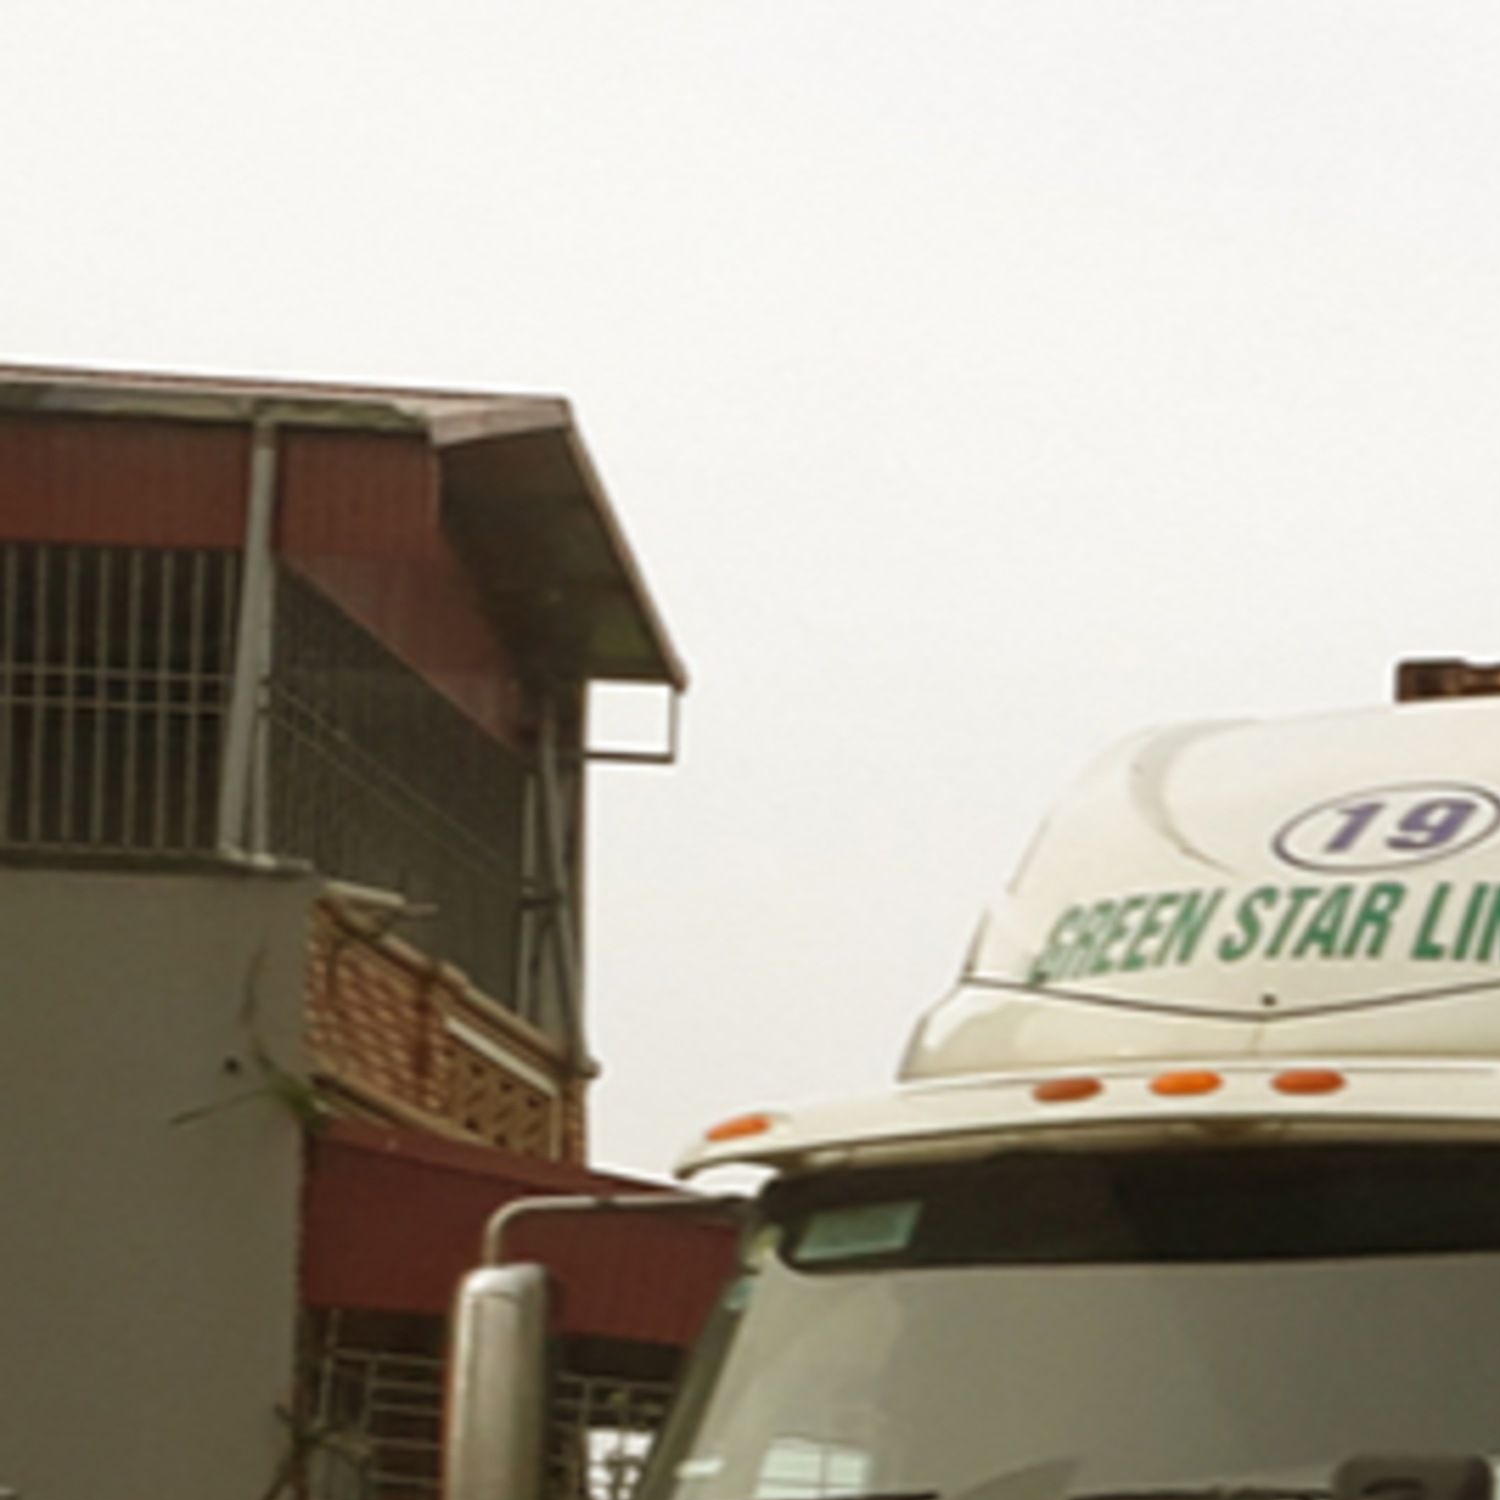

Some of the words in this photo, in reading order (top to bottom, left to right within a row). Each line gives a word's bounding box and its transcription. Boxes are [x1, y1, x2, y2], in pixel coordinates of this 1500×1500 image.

[1325, 799, 1478, 853] 19
[1031, 887, 1226, 983] GREEN
[1218, 882, 1405, 962] STAR
